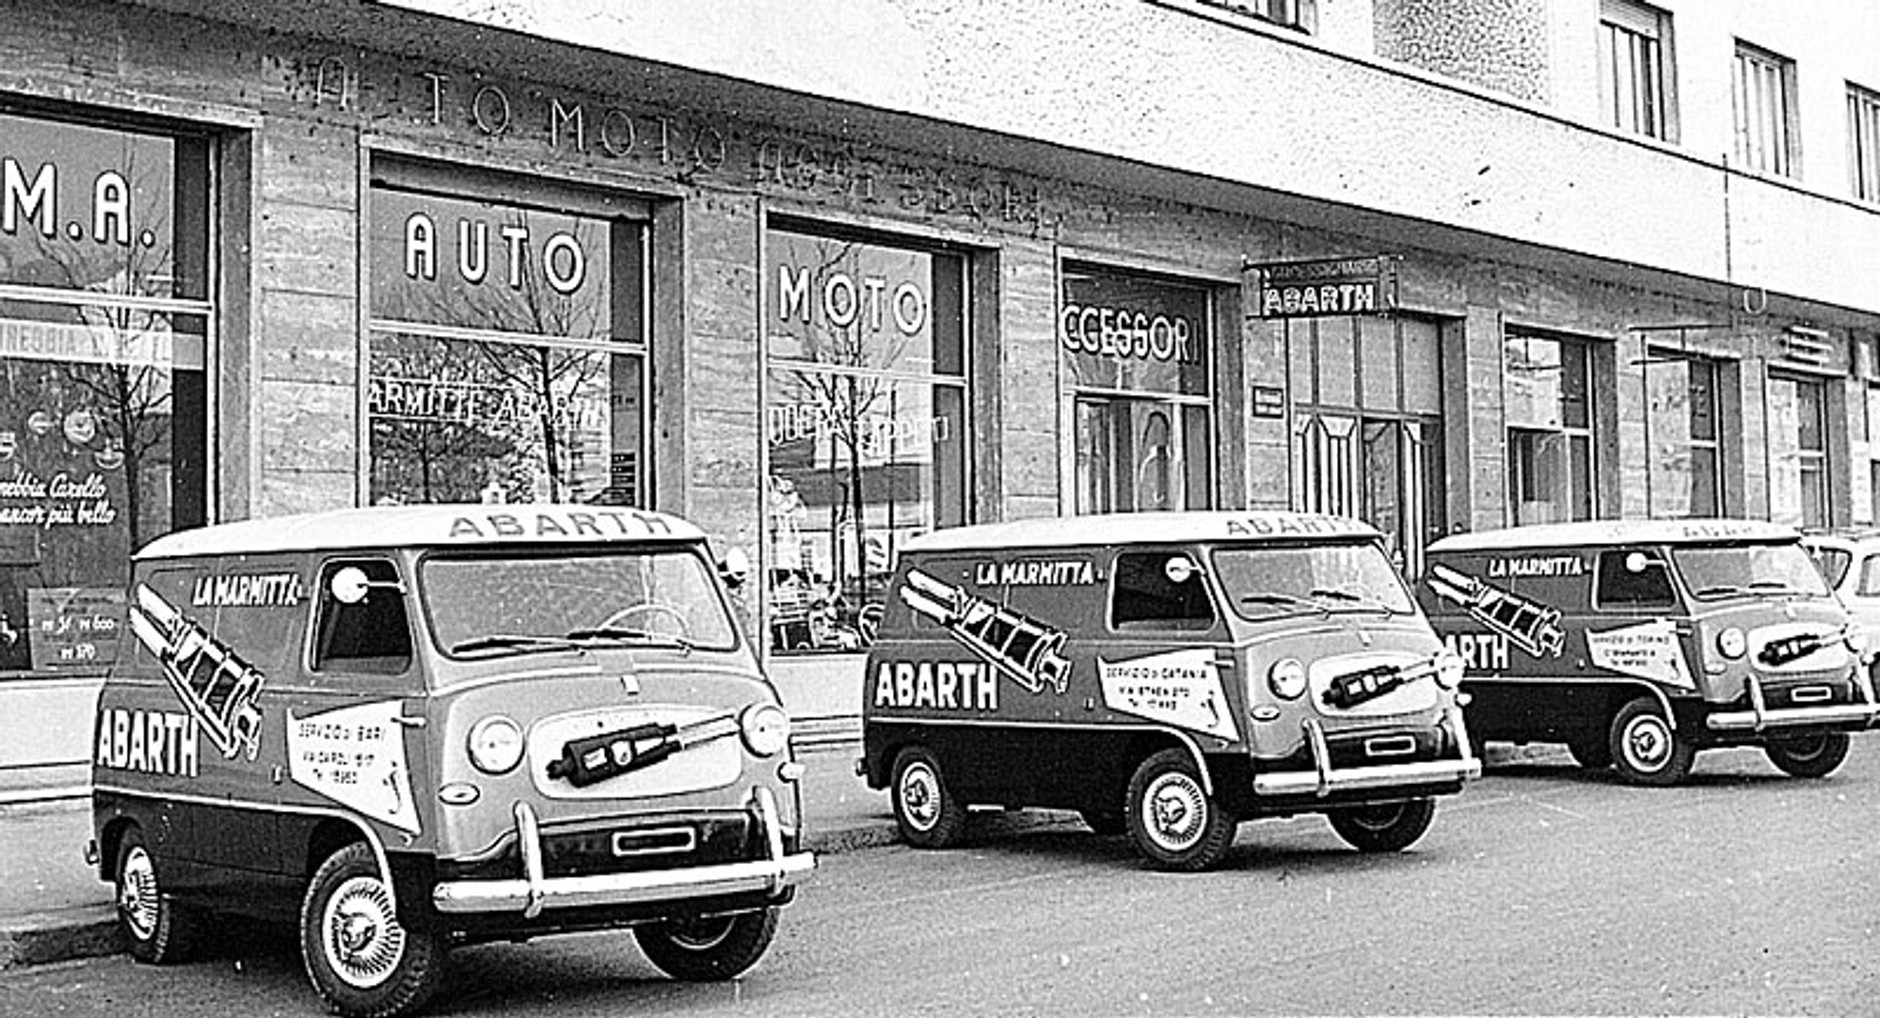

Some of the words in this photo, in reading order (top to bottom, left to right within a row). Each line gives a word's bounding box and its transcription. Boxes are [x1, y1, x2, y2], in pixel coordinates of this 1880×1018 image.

[316, 56, 511, 136] ATO
[404, 212, 586, 295] AUTO
[779, 264, 925, 336] MOTO
[1263, 284, 1374, 316] ABARTH
[77, 500, 116, 524] bello
[449, 511, 671, 538] ABARTH
[975, 563, 998, 585] LA
[1001, 561, 1094, 585] MARMITTA
[1489, 559, 1506, 577] LA
[192, 577, 212, 606] LA
[874, 662, 999, 710] ABARTH
[97, 708, 199, 777] ABARTH
